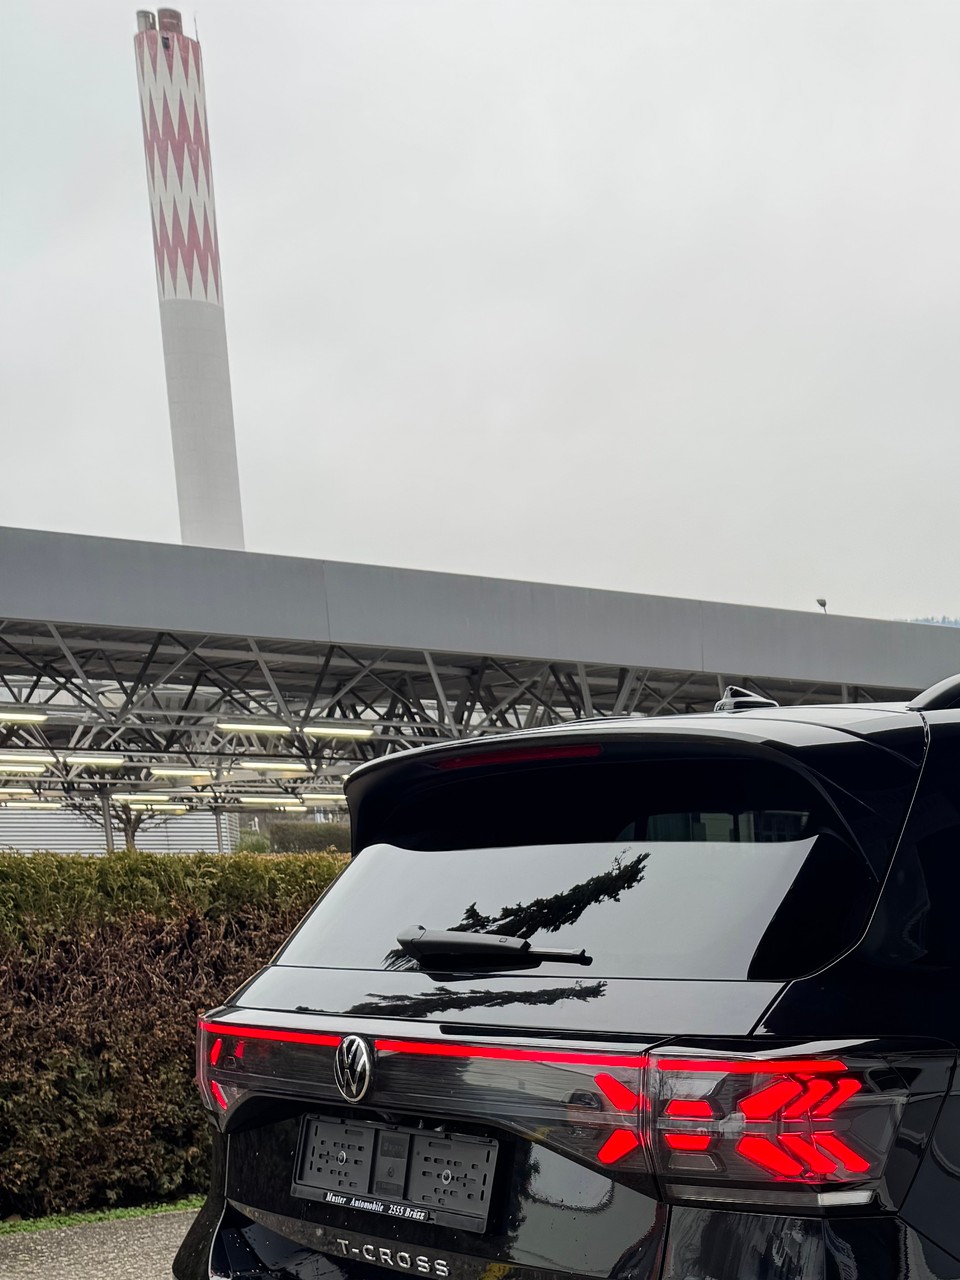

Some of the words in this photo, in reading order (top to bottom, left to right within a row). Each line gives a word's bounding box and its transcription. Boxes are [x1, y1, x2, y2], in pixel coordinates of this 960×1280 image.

[350, 1197, 384, 1212] Automobile
[387, 1205, 404, 1216] 2555
[336, 1238, 450, 1276] T-CROSS
